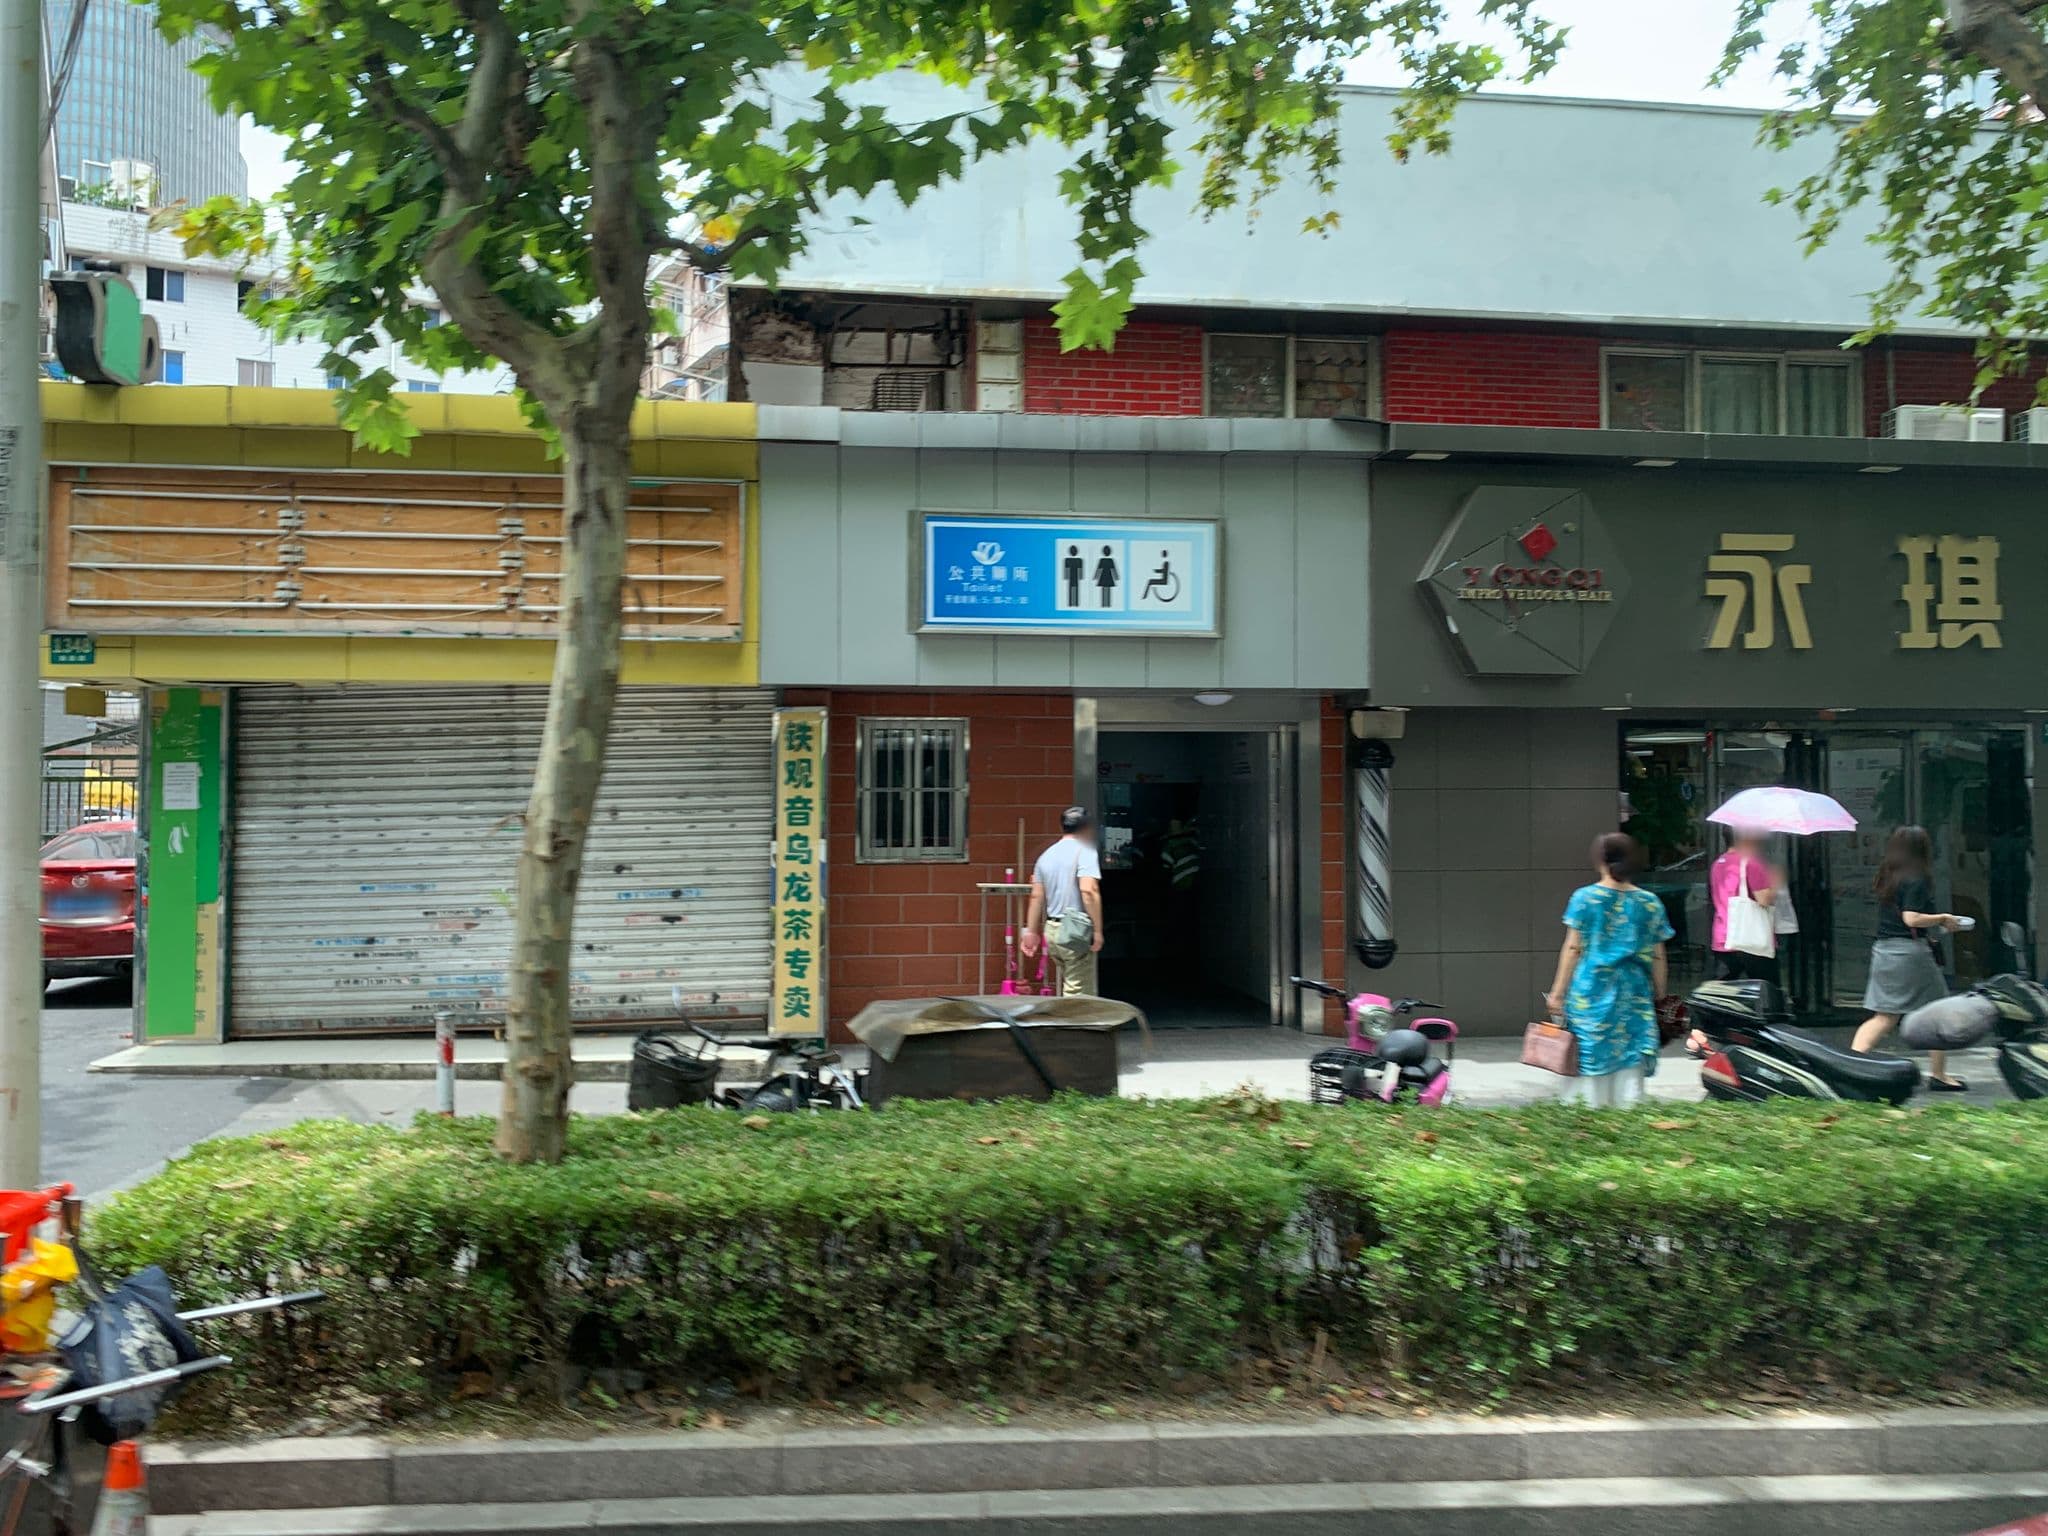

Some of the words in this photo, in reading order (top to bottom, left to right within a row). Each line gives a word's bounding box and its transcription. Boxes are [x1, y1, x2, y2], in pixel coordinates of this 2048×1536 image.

[1704, 532, 2003, 650] 永琪
[783, 719, 814, 1018] 铁观音乌龙茶专卖
